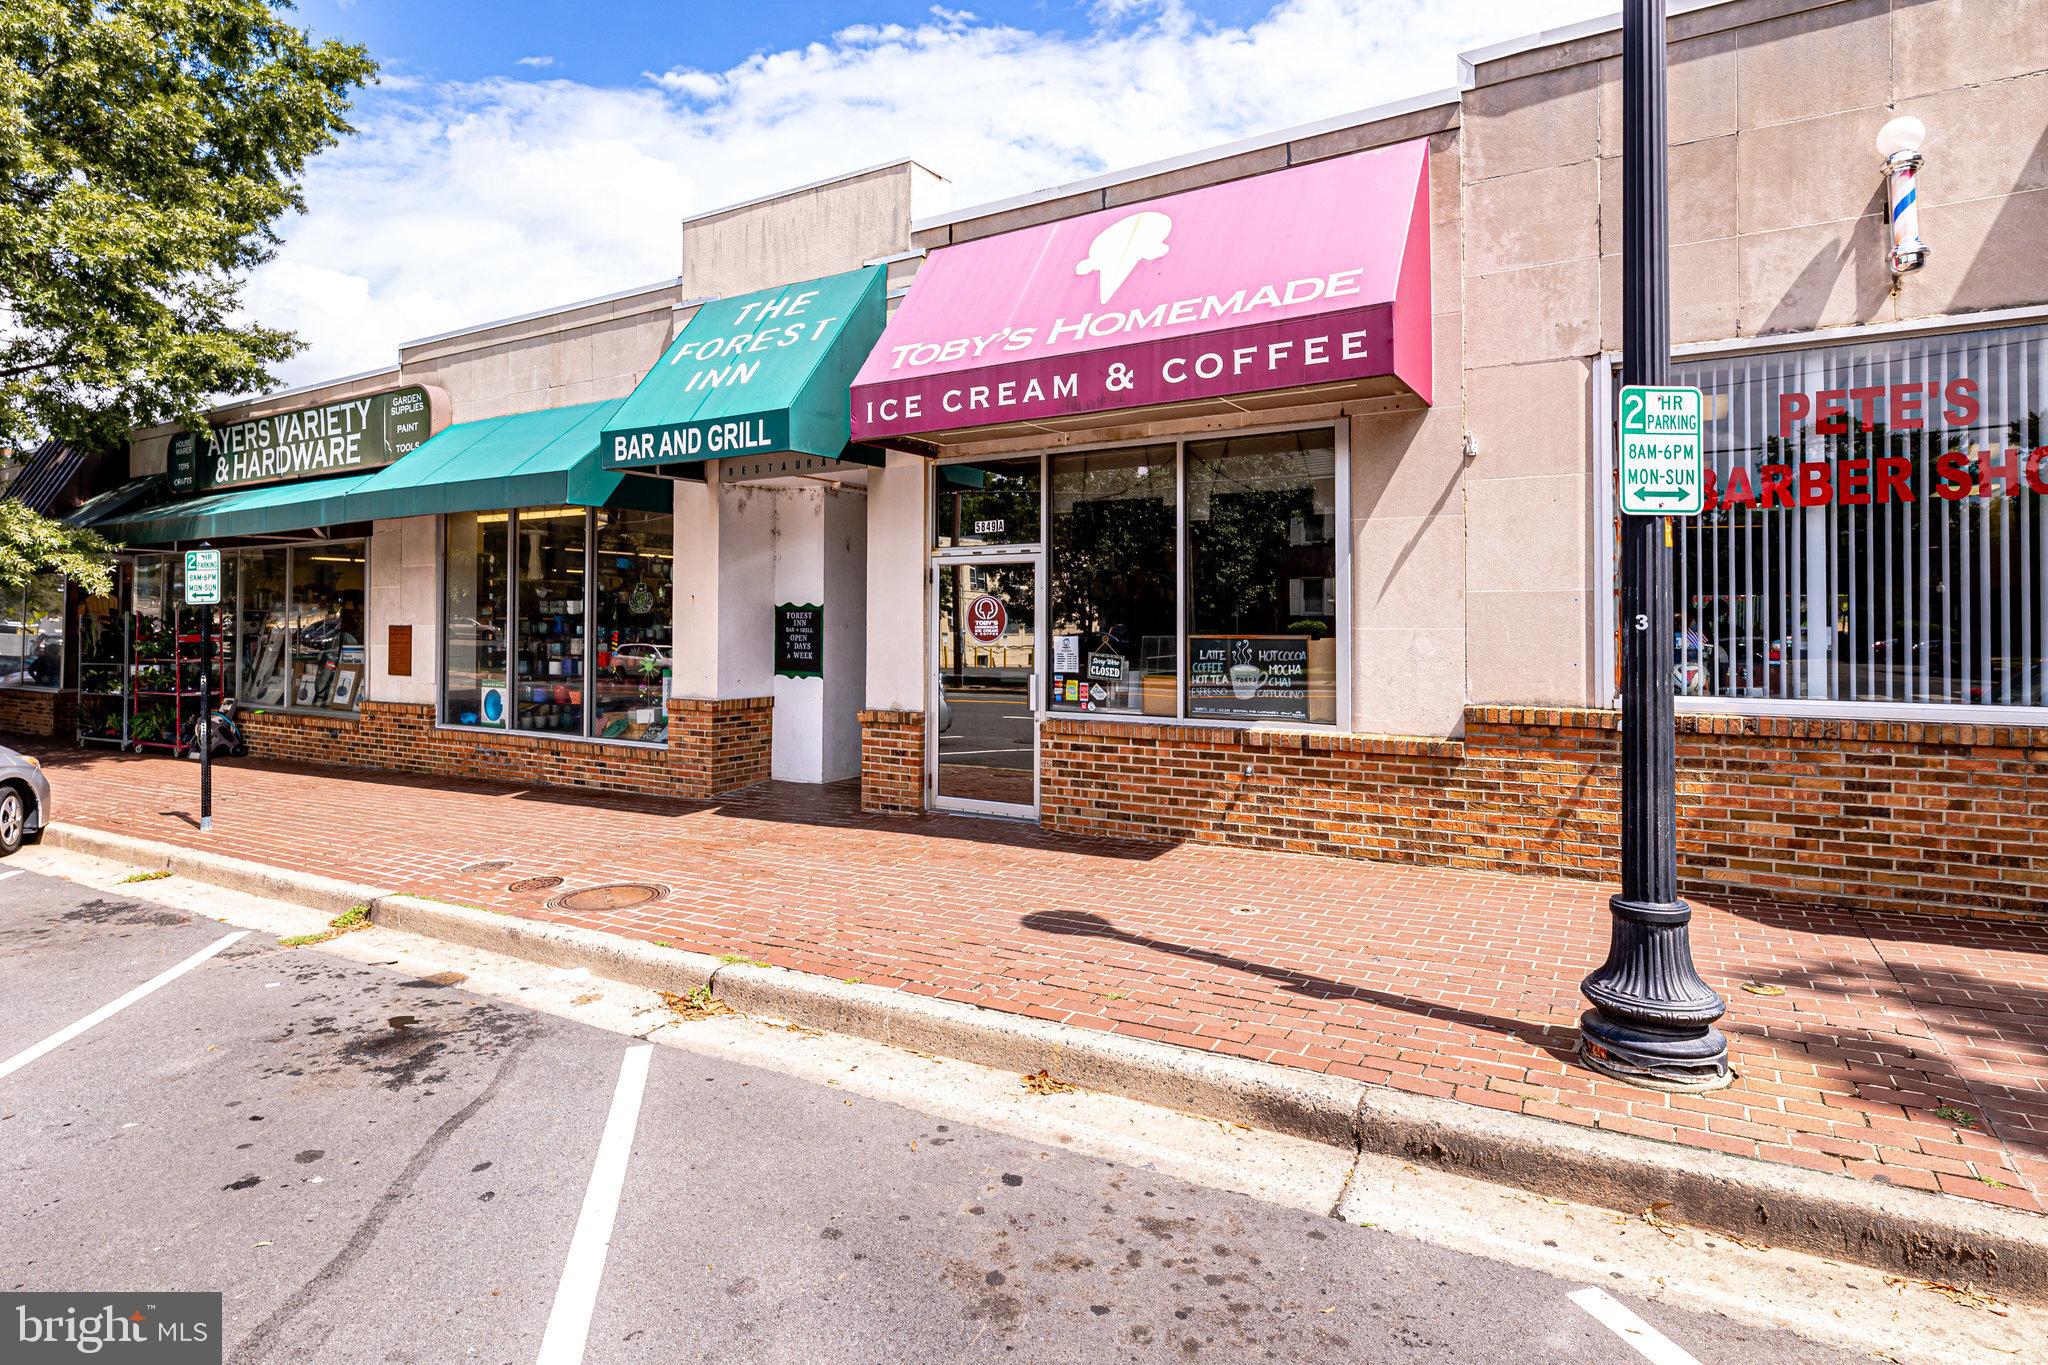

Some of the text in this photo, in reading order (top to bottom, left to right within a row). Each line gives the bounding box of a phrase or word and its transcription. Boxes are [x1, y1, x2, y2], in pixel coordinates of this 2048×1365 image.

[733, 290, 820, 326] THE
[890, 268, 1364, 370] TOBY'S HOMEMADE
[670, 317, 837, 366] FOREST
[684, 360, 760, 392] INN
[866, 329, 1368, 423] ICE CREAM & COFFEE
[392, 393, 422, 406] GARDEN
[391, 402, 424, 416] SUPPLIES
[1625, 394, 1683, 429] 2 HR
[1779, 378, 1980, 438] PETE'S
[207, 399, 372, 456] AYERS VARIETY
[397, 422, 418, 433] PAINT
[1648, 414, 1697, 430] PARKING
[395, 441, 419, 453] TOOLS
[614, 419, 771, 462] BAR AND GRILL
[215, 432, 361, 483] & HARDWARE
[1629, 443, 1694, 460] 8AM-6PM
[728, 457, 842, 477] RESTAURAN
[1628, 468, 1695, 486] MON-SUN
[188, 554, 196, 569] 2
[190, 573, 217, 581] 8AM-6PM
[189, 583, 217, 592] MON-SUN
[786, 611, 813, 619] FOREST
[1635, 614, 1648, 630] 3
[793, 619, 807, 627] INN
[790, 634, 808, 642] OPEN
[794, 642, 812, 650] DAYS
[793, 651, 813, 659] WEEK
[1199, 649, 1227, 661] LATTE
[1091, 665, 1120, 678] CLOSED
[1192, 662, 1224, 673] COFFEE
[1268, 664, 1302, 676] MOCHA
[1191, 674, 1229, 685] HOT TEA
[1268, 677, 1292, 687] CHAI
